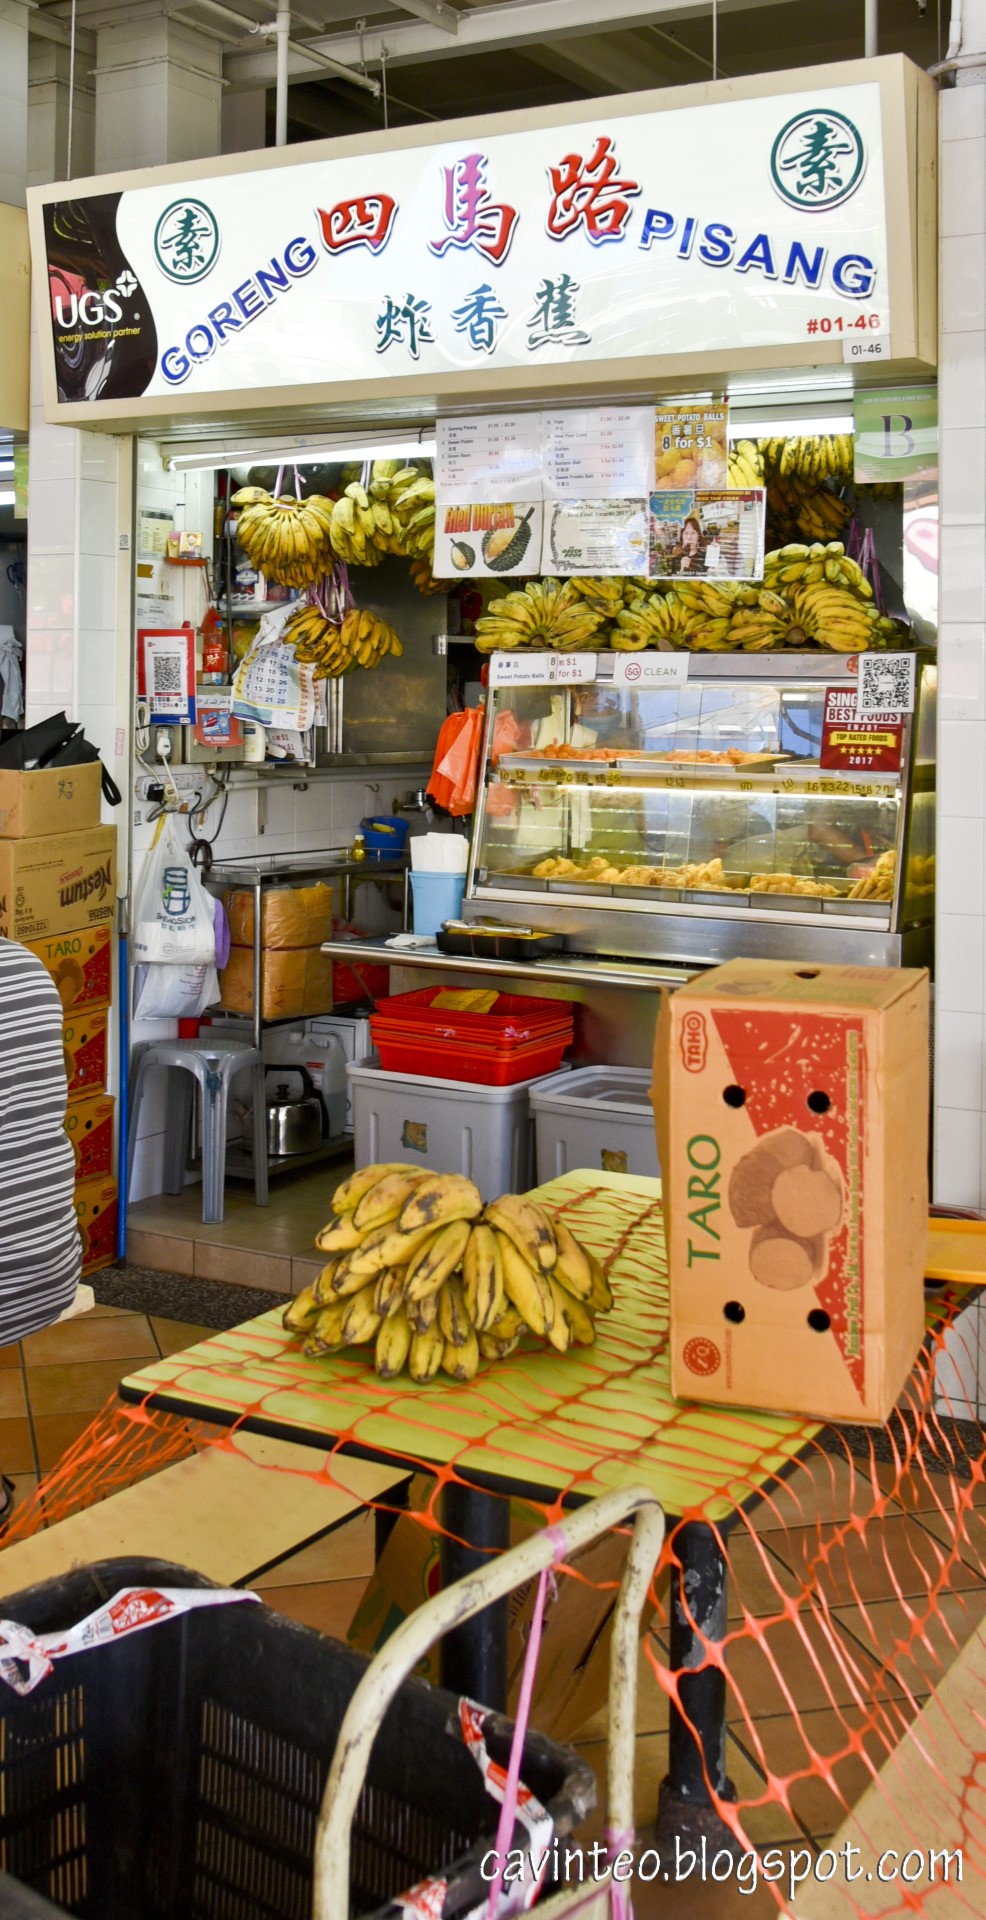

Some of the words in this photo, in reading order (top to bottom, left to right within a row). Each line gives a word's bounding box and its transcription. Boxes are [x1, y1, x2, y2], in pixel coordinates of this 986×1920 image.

[779, 120, 852, 195] 素
[317, 136, 640, 265] 四馬路
[161, 209, 210, 272] 素
[55, 289, 123, 328] UGS
[160, 236, 317, 382] GORENG
[640, 209, 877, 296] PISANG
[375, 274, 592, 360] 炸香蕉
[807, 314, 880, 334] #01-46
[59, 333, 82, 343] energy
[85, 330, 111, 340] solution
[114, 327, 140, 338] partner
[852, 344, 881, 355] 01-46
[655, 414, 674, 422] SWEET
[704, 412, 724, 420] BALLS
[663, 436, 670, 449] 8
[675, 437, 693, 448] for
[697, 436, 712, 449] $1
[880, 414, 915, 456] B
[550, 658, 556, 666] 8
[566, 658, 577, 666] $1
[644, 668, 677, 676] CLEAN
[829, 708, 856, 720] BEST
[849, 756, 873, 764] 2017
[60, 856, 112, 908] Nestum
[45, 938, 82, 958] TARO
[684, 1015, 705, 1070] TAHO
[686, 1134, 721, 1268] TARO
